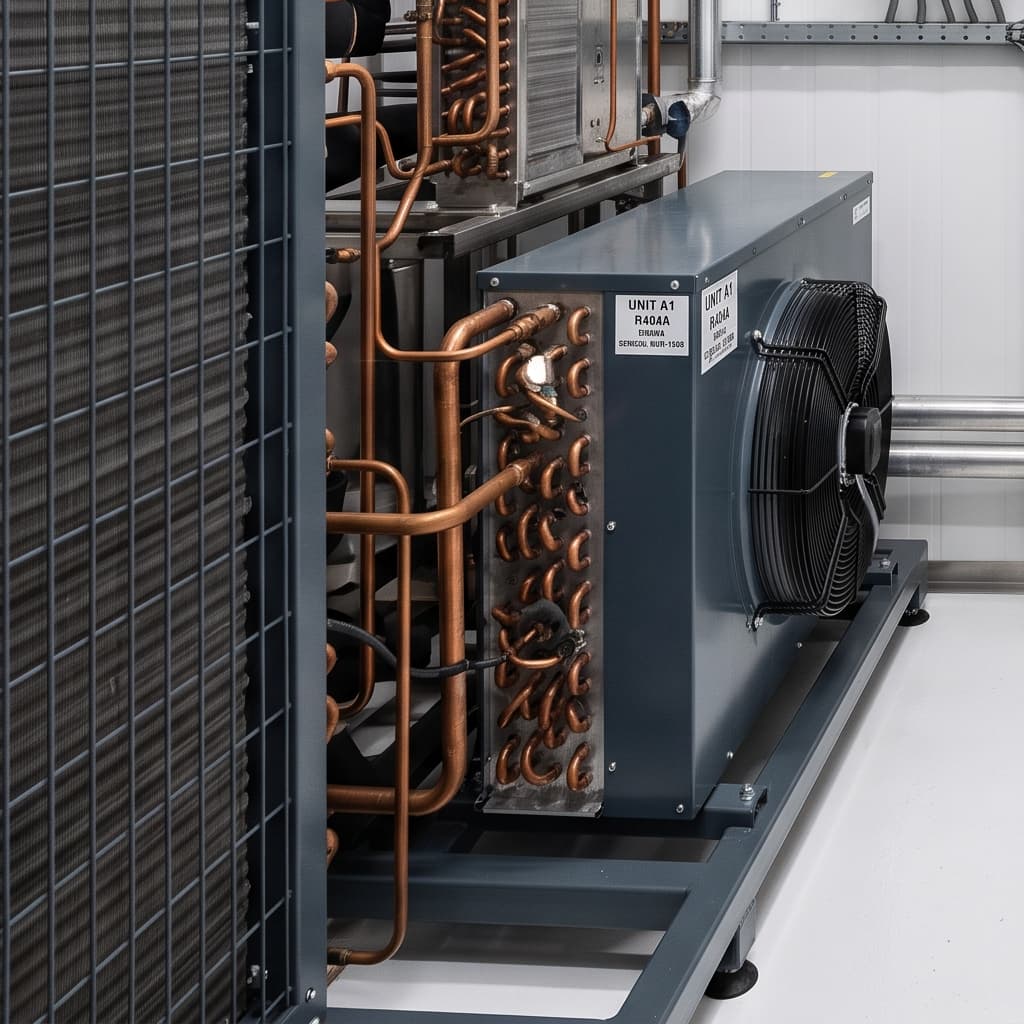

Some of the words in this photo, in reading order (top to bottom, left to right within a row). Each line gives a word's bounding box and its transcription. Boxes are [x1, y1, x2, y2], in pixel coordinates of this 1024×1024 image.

[705, 287, 722, 311] UNIT
[723, 281, 733, 300] A1
[628, 299, 656, 311] UNIT
[660, 300, 675, 311] A1
[634, 315, 670, 326] R404A
